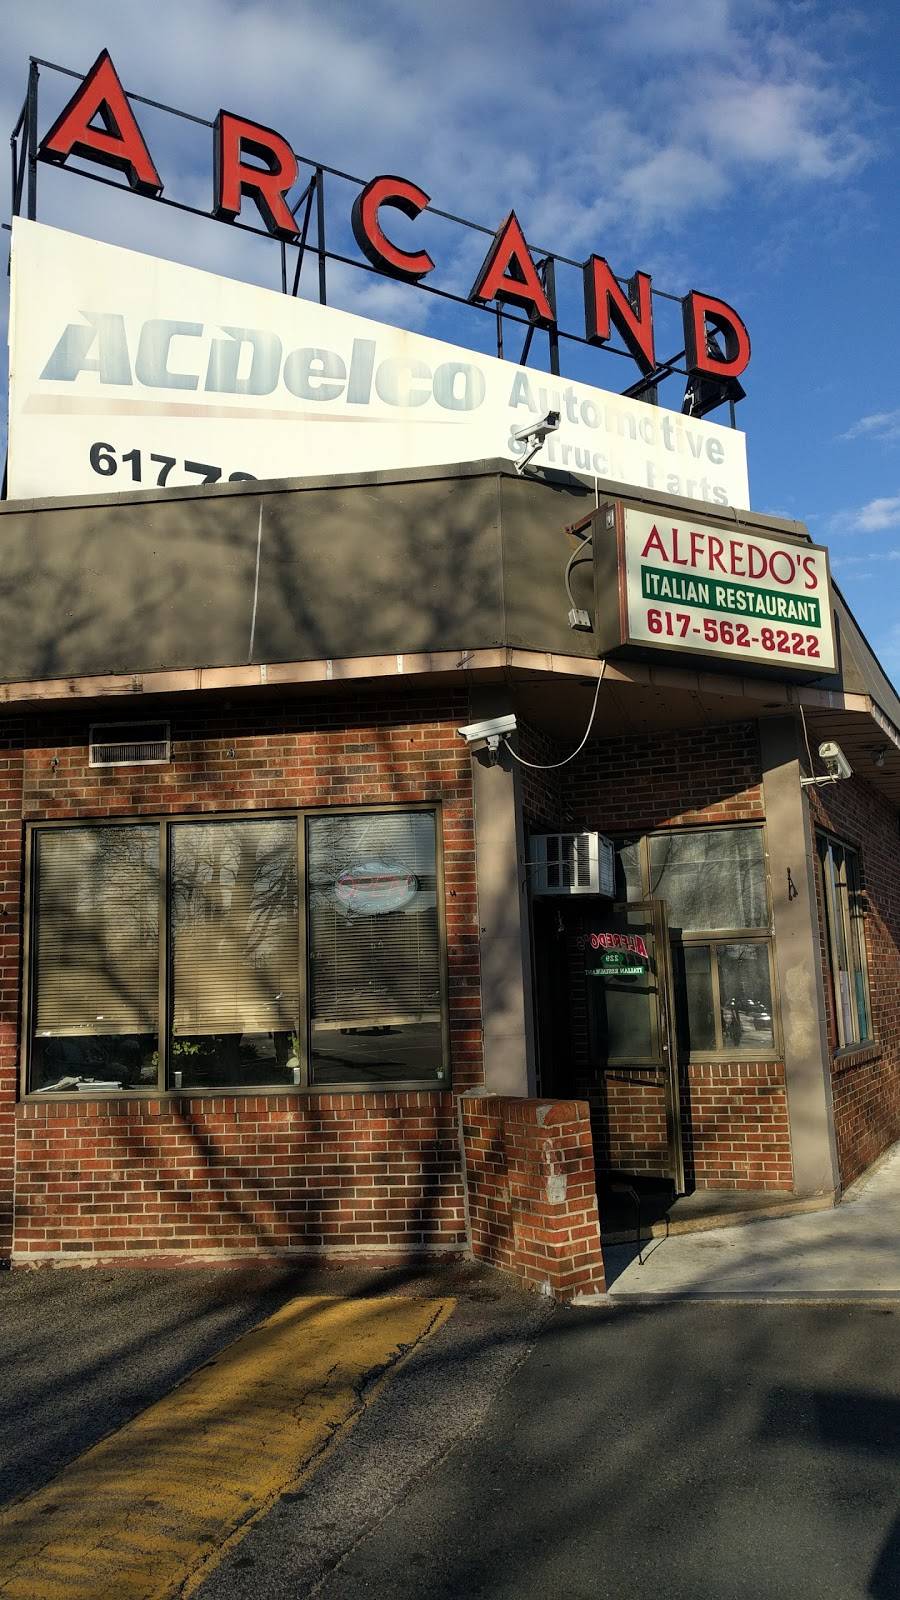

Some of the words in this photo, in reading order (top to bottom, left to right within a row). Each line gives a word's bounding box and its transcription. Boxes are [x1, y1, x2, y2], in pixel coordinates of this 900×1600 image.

[39, 48, 751, 379] ARCAND
[39, 309, 486, 414] ACDelco
[641, 524, 818, 590] ALFREDO'S
[645, 572, 710, 604] ITALIAN
[716, 586, 817, 623] RESTAURANT
[647, 608, 821, 659] 617-562-8222
